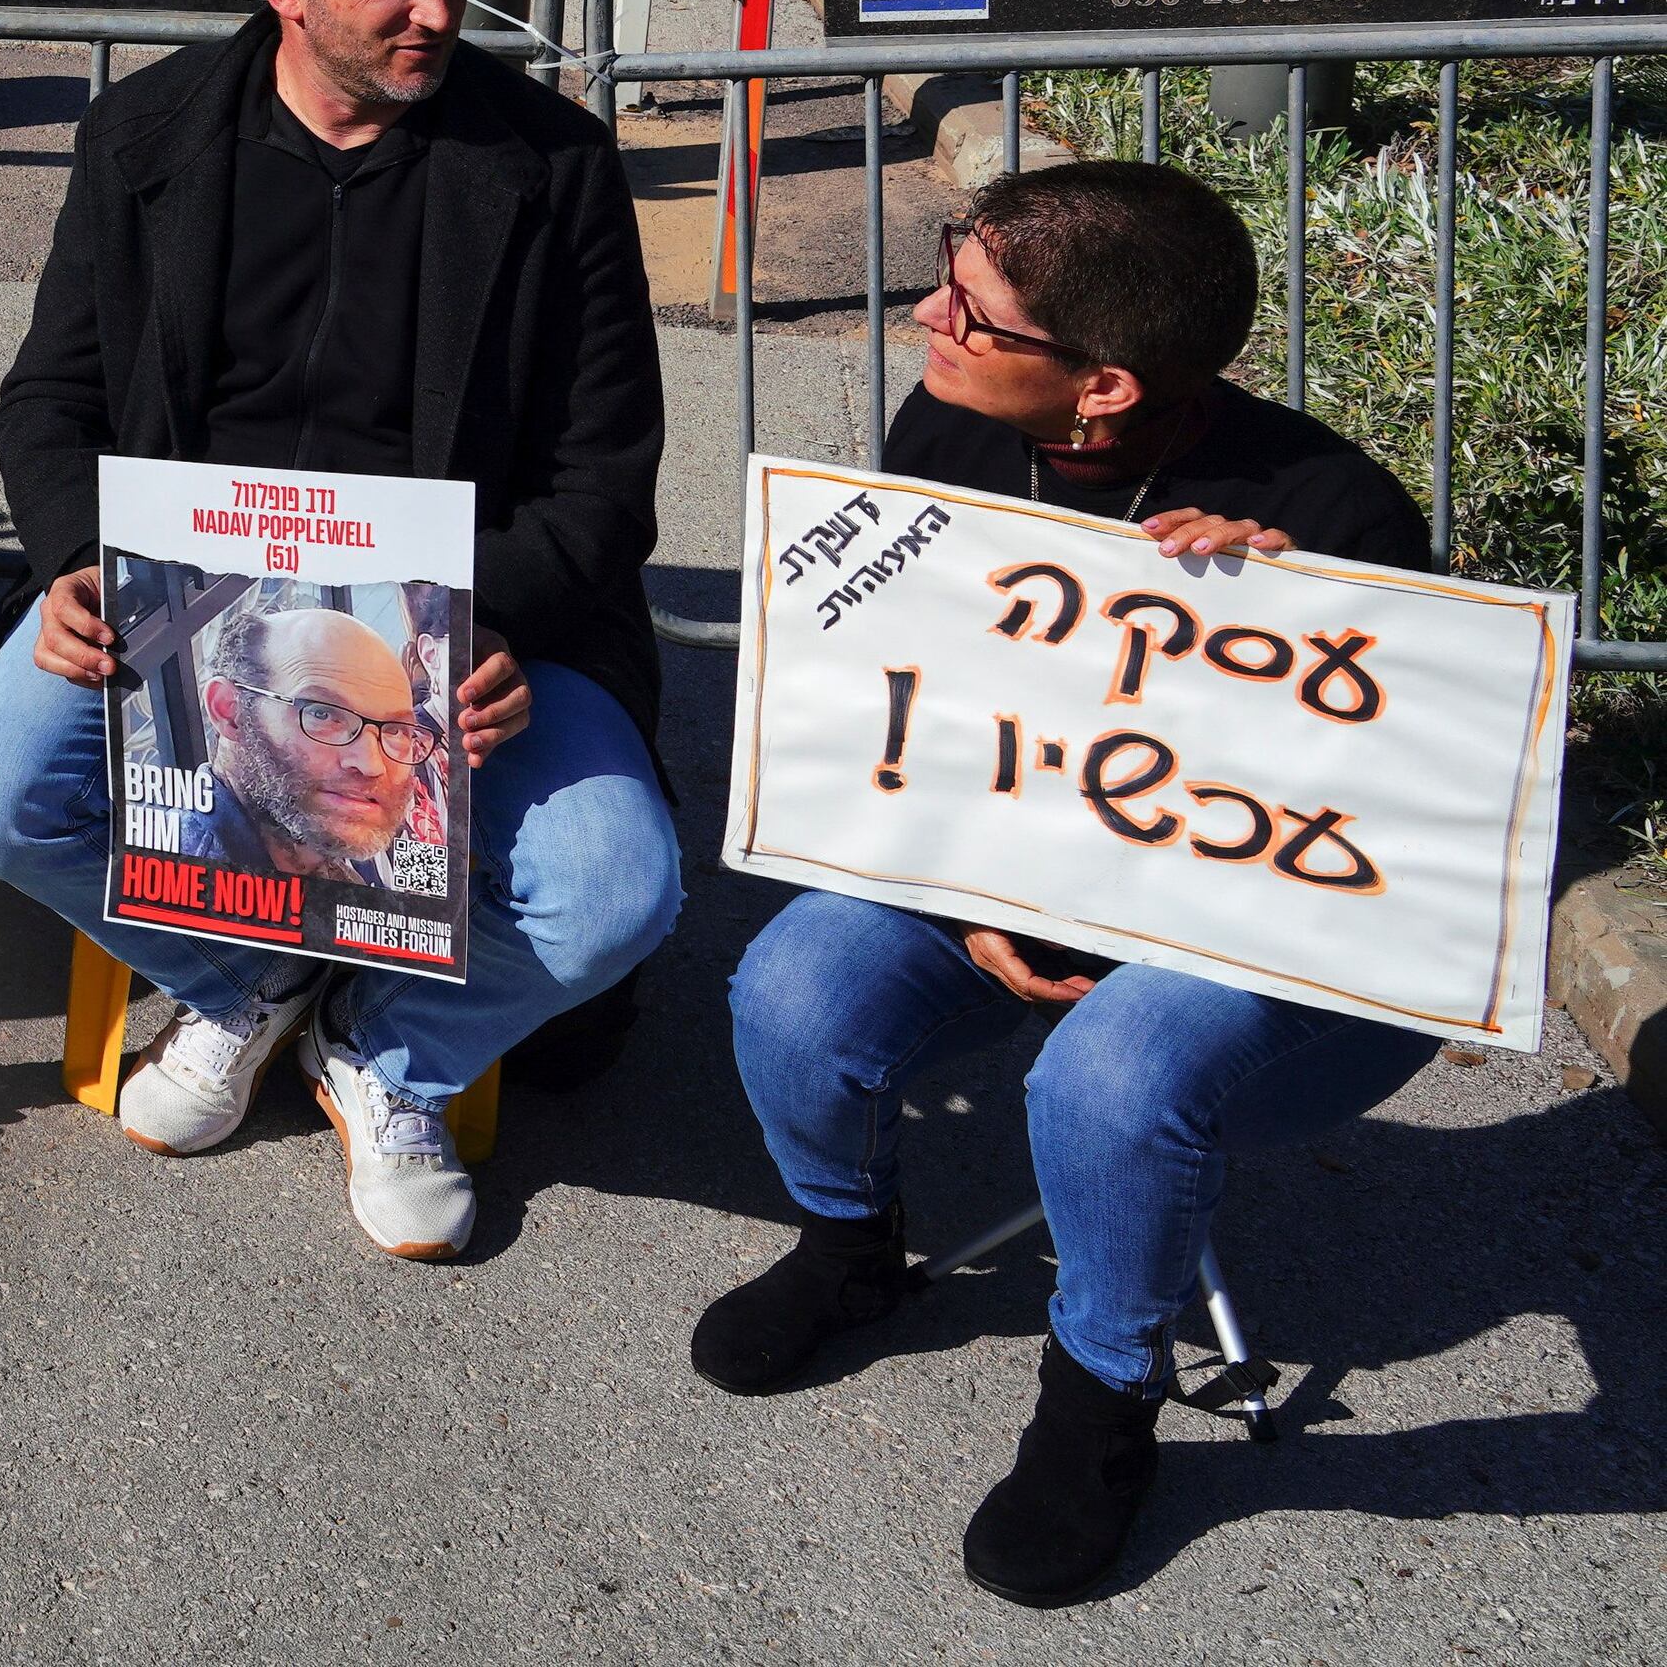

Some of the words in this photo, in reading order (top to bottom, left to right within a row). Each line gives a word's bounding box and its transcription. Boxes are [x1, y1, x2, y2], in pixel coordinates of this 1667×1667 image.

[231, 480, 301, 513] פופלוול
[306, 485, 336, 516] נדב
[192, 508, 254, 538] NADAV
[257, 515, 376, 549] POPPLEWELL
[265, 544, 300, 574] (51)
[985, 562, 1388, 725] עסקה
[124, 762, 214, 814] BRING
[124, 805, 180, 855] HIM
[122, 854, 207, 909] HOME
[213, 870, 303, 927] NOW!
[335, 918, 399, 950] FAMILIES
[401, 929, 451, 959] FORUM
[336, 904, 385, 926] HOSTAGES
[386, 910, 406, 930] AND
[407, 915, 451, 938] MISSING
